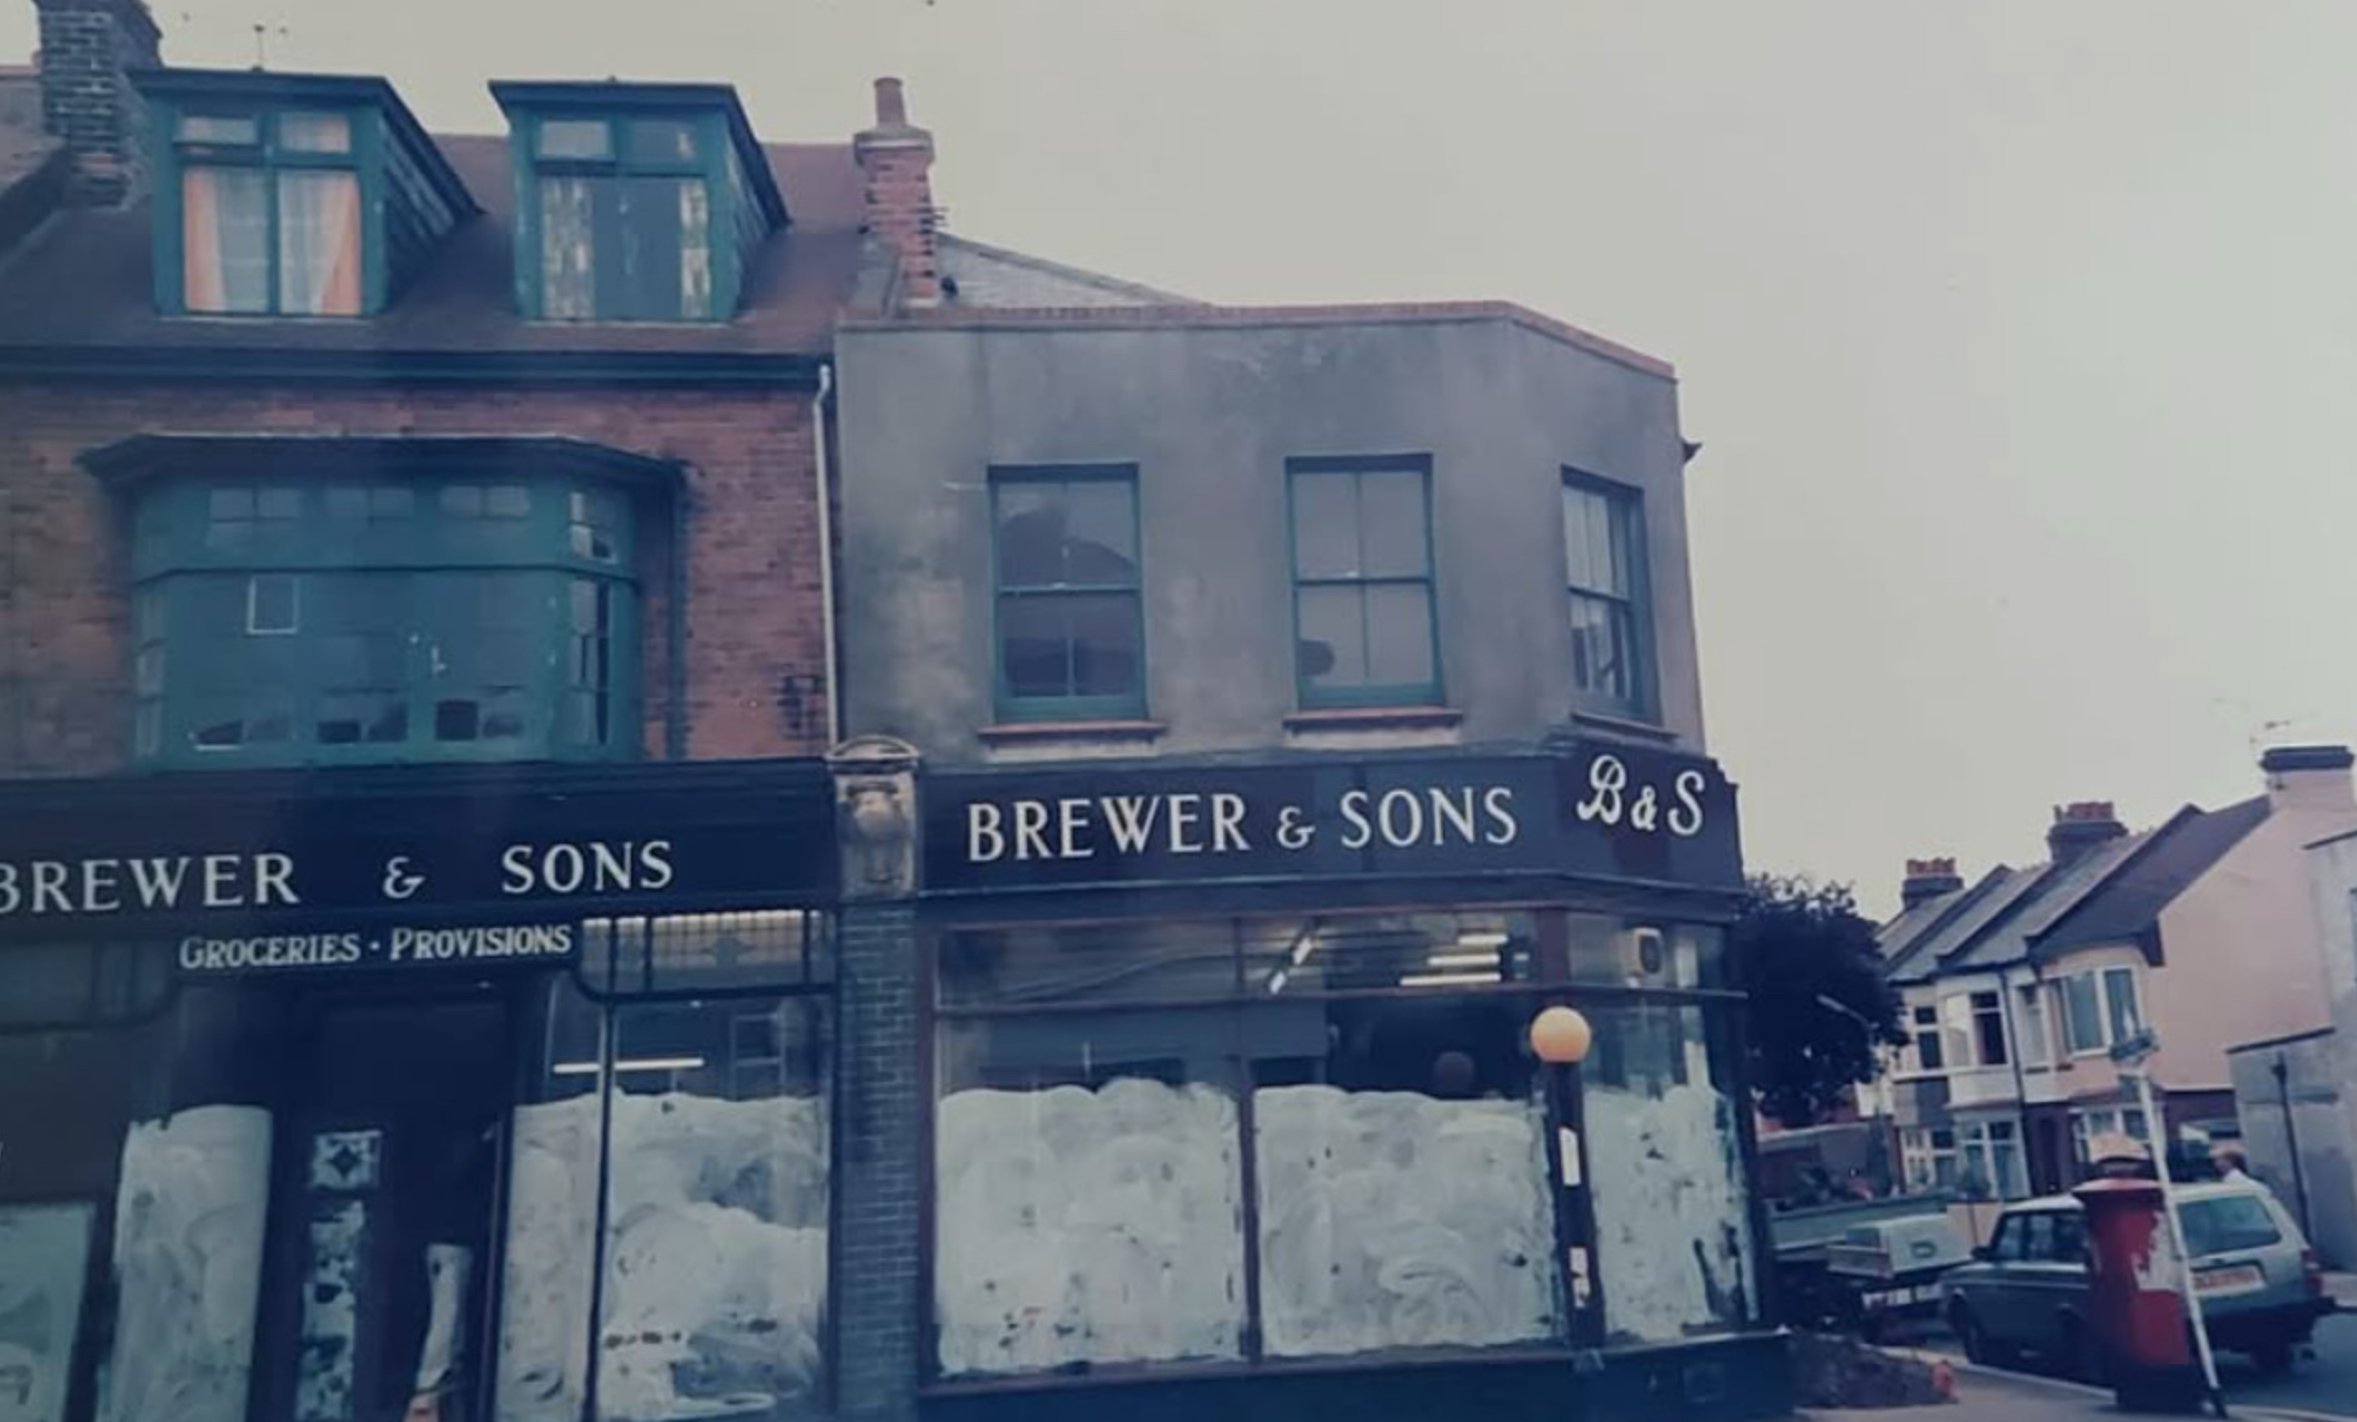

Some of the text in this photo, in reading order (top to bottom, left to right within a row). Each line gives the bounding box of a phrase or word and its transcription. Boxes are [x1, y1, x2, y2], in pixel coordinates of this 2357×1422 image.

[968, 786, 1517, 861] BREWER & SONS
[383, 856, 424, 899] &
[502, 840, 673, 893] SONS
[179, 925, 572, 969] GROCERIES PROVISIONS
